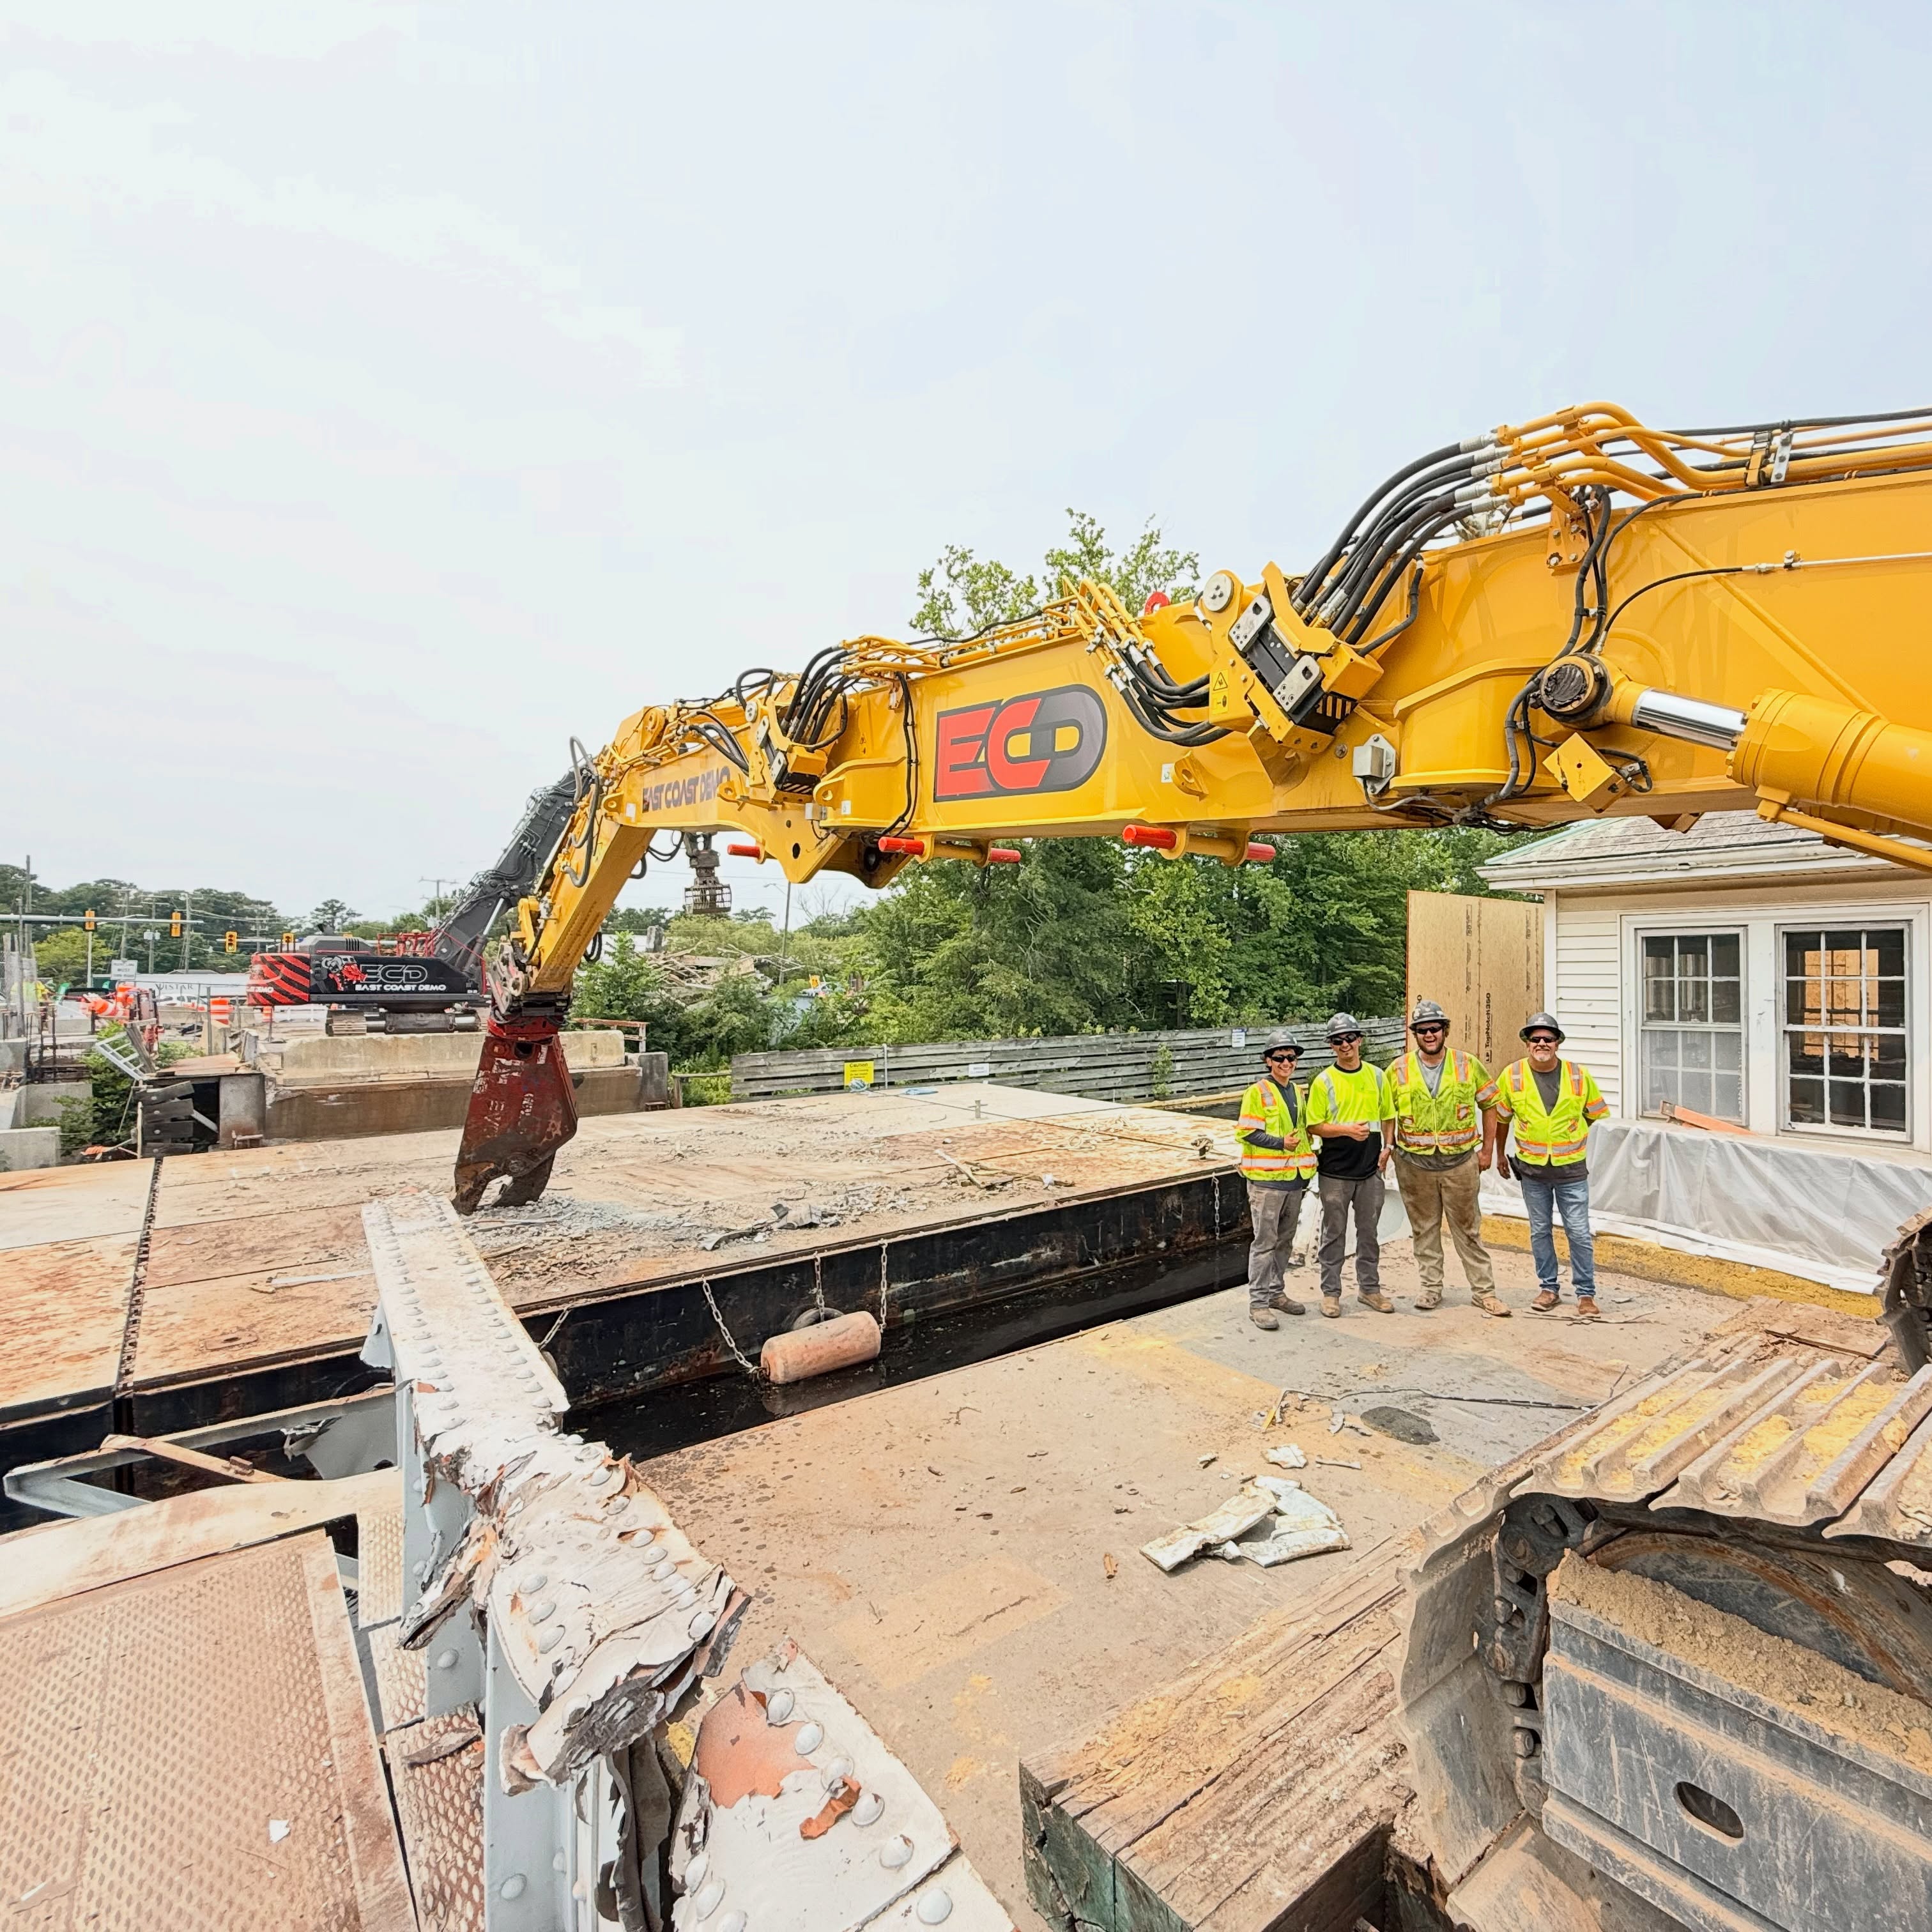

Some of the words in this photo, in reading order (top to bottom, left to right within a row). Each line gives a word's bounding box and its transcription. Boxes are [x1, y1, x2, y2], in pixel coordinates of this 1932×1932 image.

[933, 684, 1108, 803] ECD
[642, 783, 665, 813] EAST
[665, 776, 700, 808] COAST
[360, 964, 427, 983] ECD
